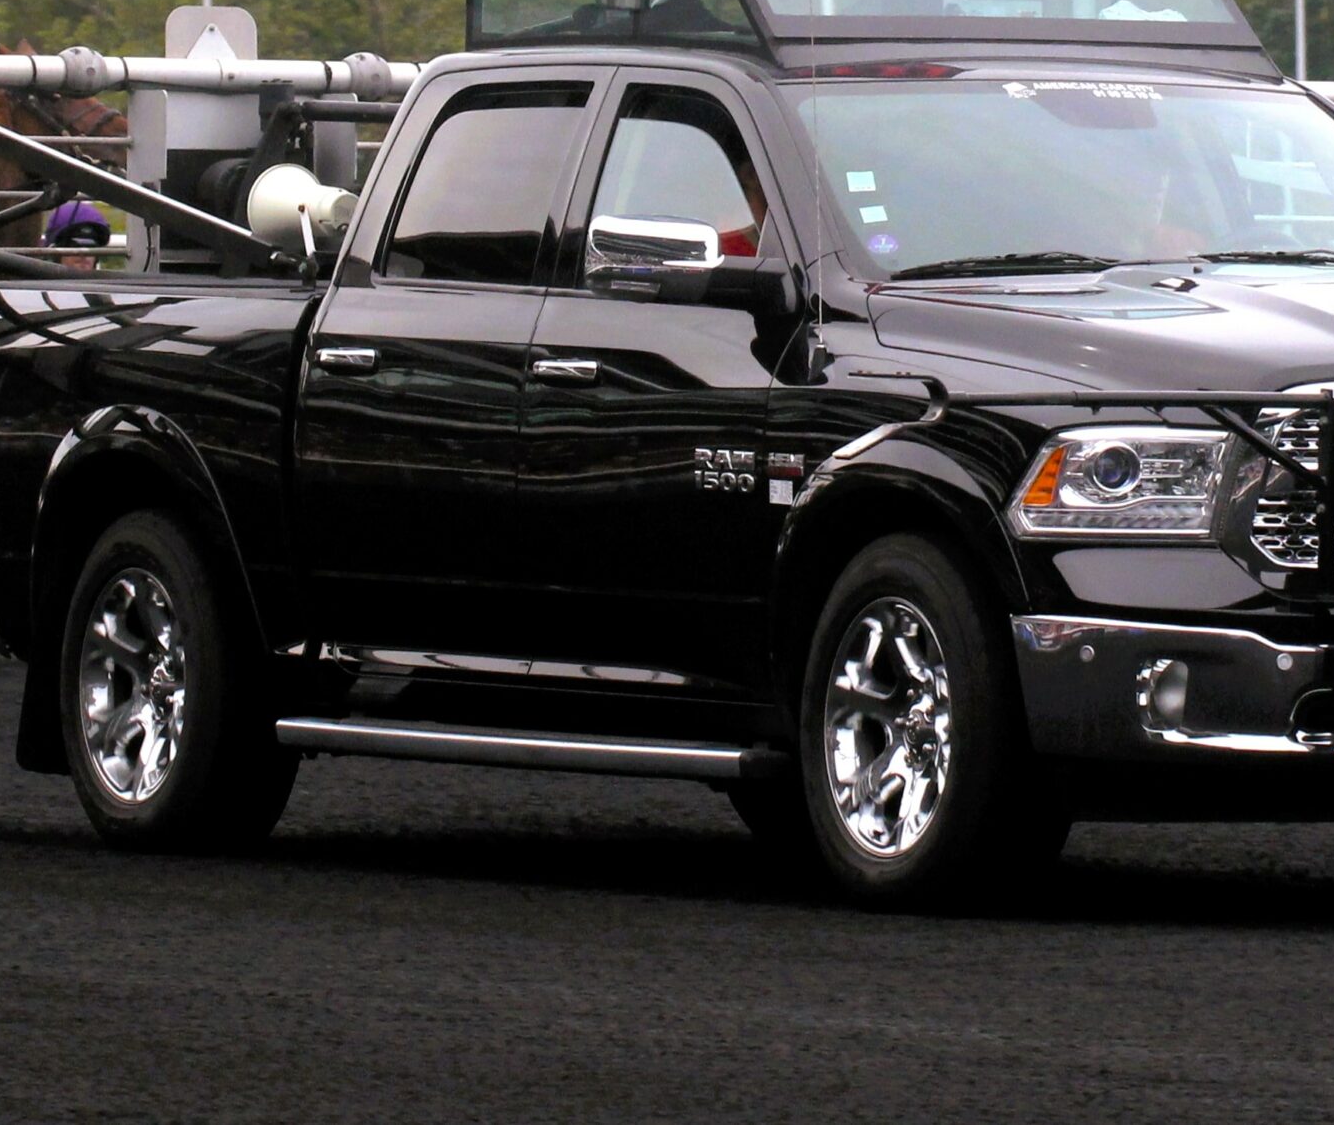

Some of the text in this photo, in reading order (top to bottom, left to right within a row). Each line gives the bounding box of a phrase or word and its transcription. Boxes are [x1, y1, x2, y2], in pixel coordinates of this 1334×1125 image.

[1033, 82, 1155, 93] AMERICAN CAR CITY
[694, 470, 756, 493] 1500
